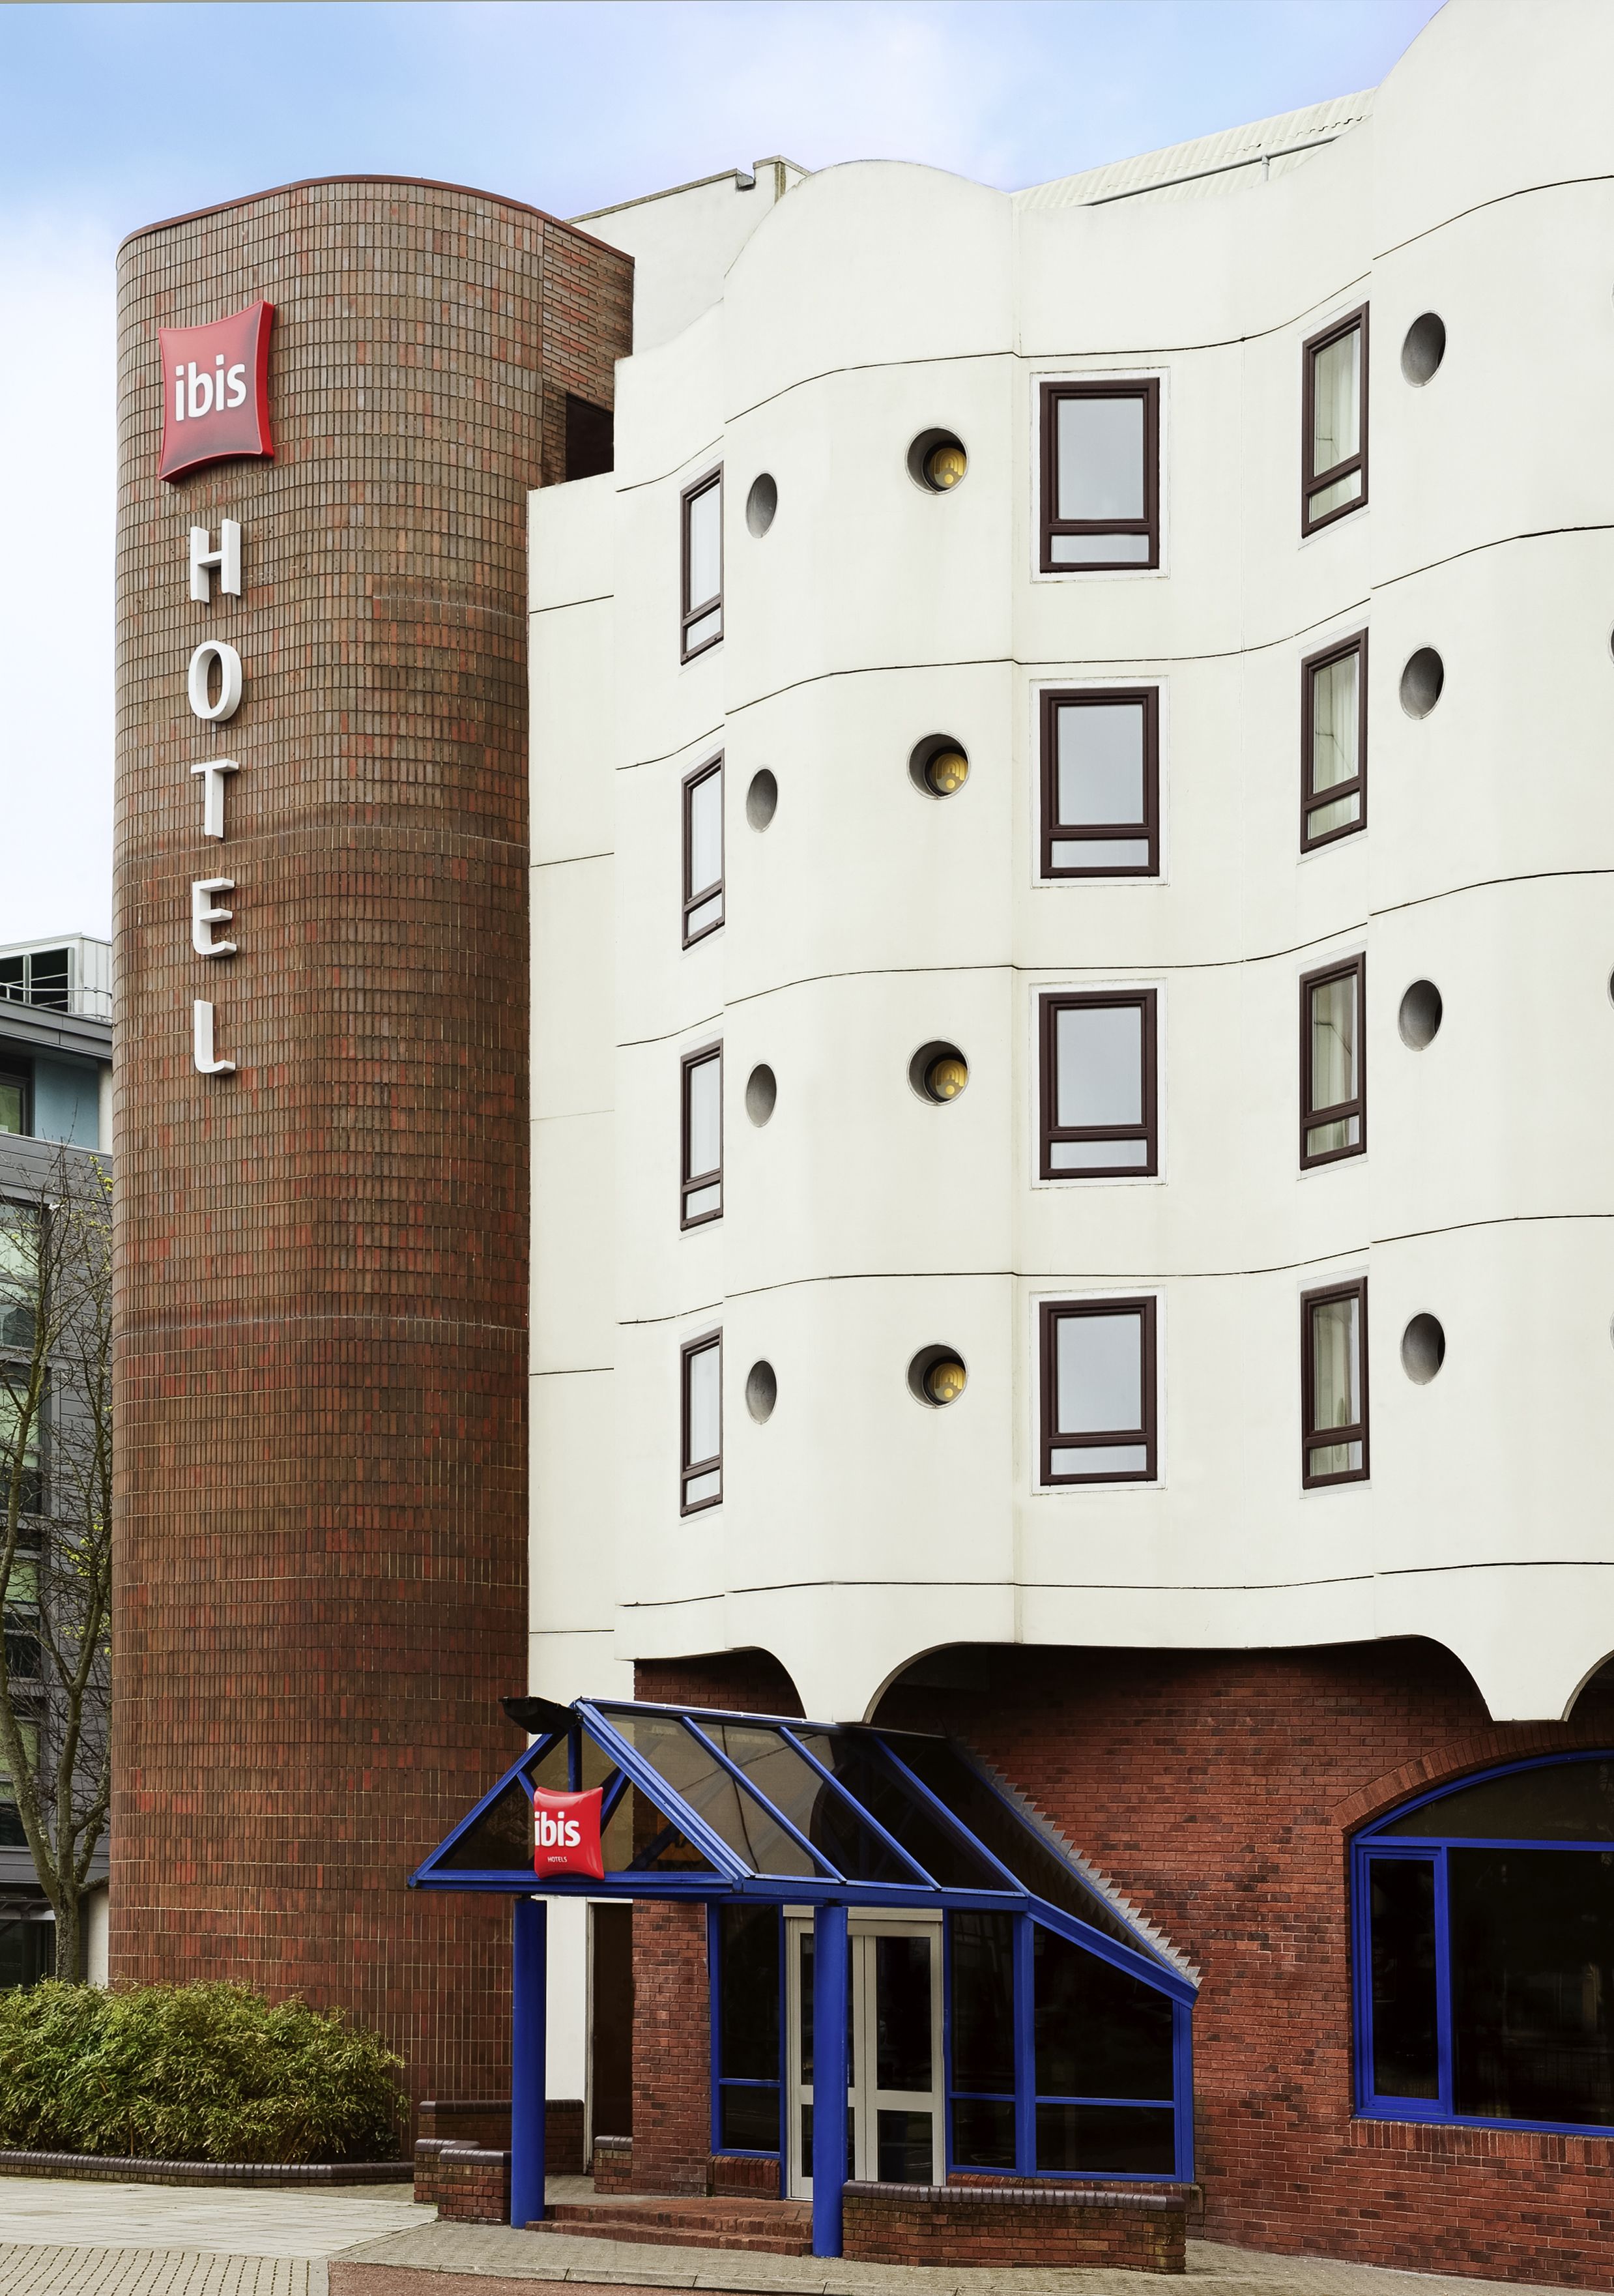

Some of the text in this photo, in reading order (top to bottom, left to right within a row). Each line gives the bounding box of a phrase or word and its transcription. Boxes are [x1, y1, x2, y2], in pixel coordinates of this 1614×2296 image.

[175, 354, 247, 422] ibis
[188, 519, 242, 1077] HOTEL
[534, 1811, 581, 1847] ibis
